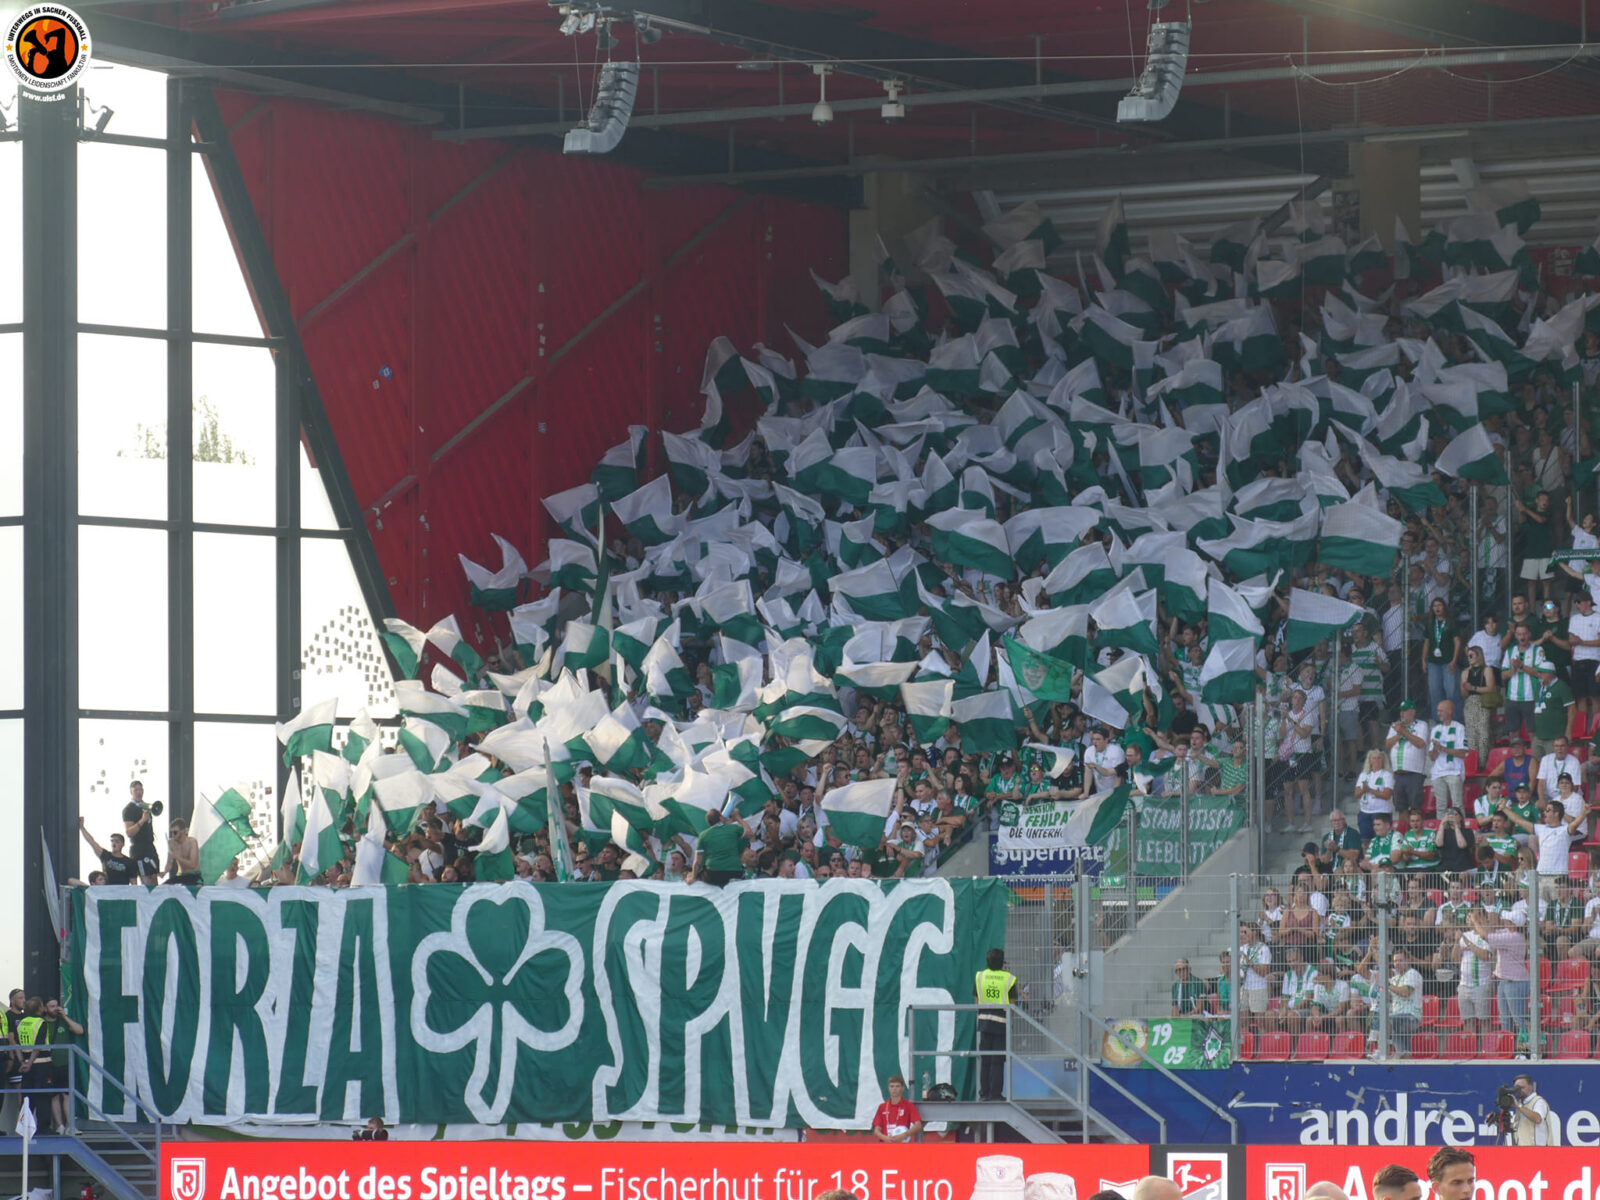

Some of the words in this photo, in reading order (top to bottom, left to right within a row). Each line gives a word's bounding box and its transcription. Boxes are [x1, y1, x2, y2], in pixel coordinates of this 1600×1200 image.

[1009, 827, 1023, 839] DIE
[986, 988, 1000, 999] 833
[85, 886, 399, 1124] FORZA
[593, 878, 954, 1131] SPVGG
[1152, 1022, 1172, 1046] 19
[1163, 1046, 1187, 1065] 03
[220, 1166, 350, 1200] Angebot
[357, 1166, 411, 1200] des
[420, 1166, 566, 1200] Spieltags
[600, 1167, 763, 1200] Fischerhut
[773, 1168, 818, 1200] für
[830, 1169, 869, 1200] 18
[882, 1169, 953, 1200] Euro
